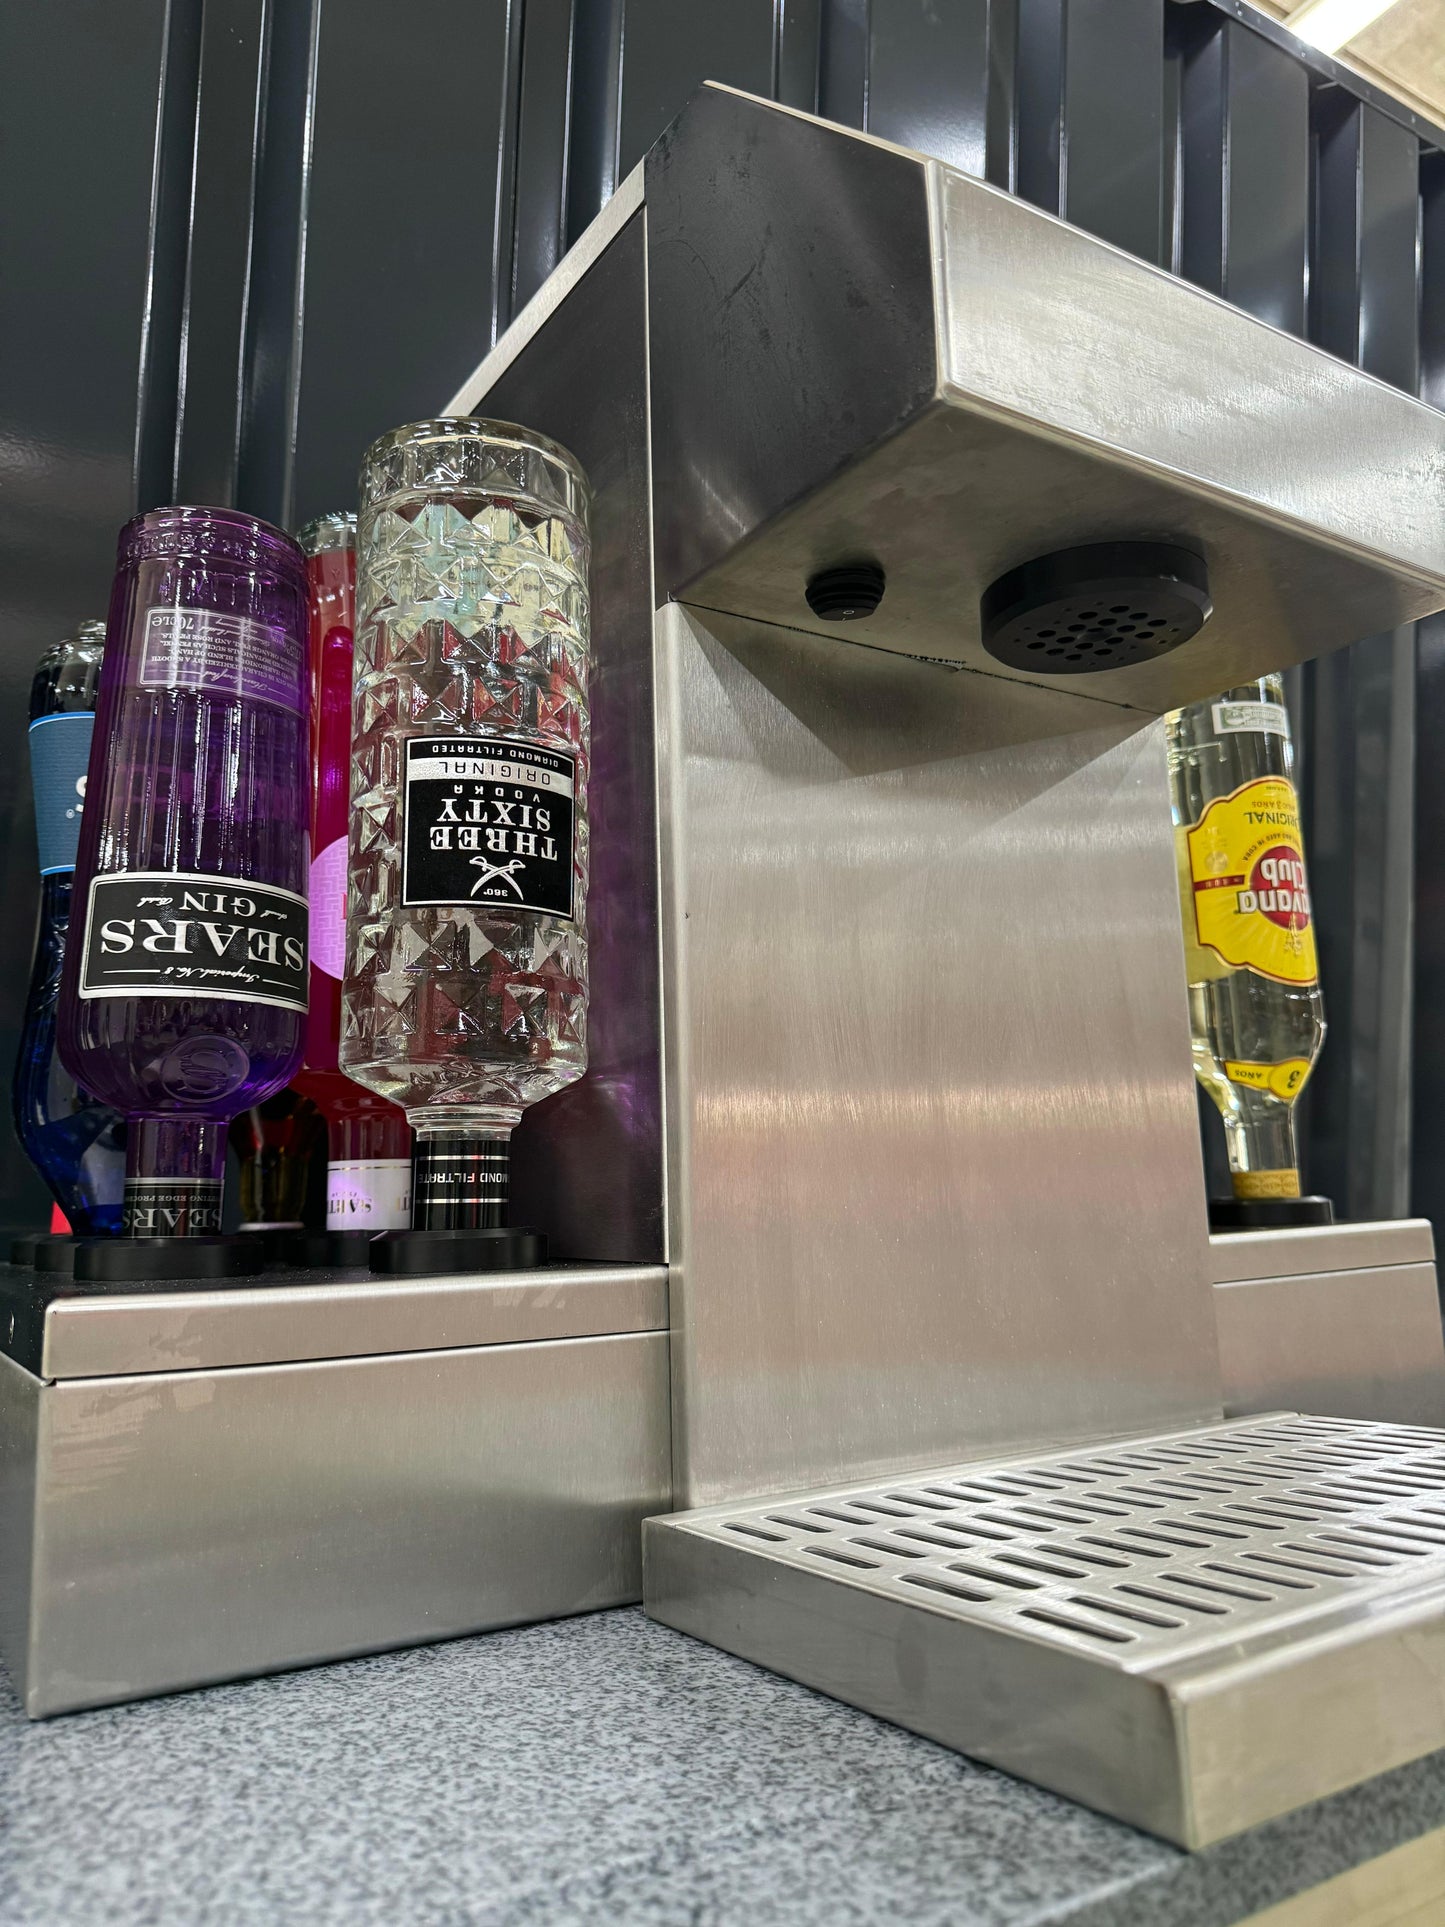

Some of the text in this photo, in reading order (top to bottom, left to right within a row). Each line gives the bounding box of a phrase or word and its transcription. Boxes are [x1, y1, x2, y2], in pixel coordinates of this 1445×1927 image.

[161, 632, 191, 640] PEALS.
[192, 634, 213, 643] ROSE
[215, 637, 231, 645] AND
[207, 651, 233, 661] BLEND
[431, 745, 558, 768] DIAMOND FILTRATED
[438, 761, 551, 786] ORIGINAL
[453, 784, 541, 803] VODKA
[436, 798, 551, 832] SIXTY
[429, 826, 558, 861] THREE
[1260, 857, 1305, 890] Club
[178, 891, 256, 917] GIN
[100, 918, 304, 972] SEARS
[164, 966, 174, 974] 8
[200, 965, 260, 983] Imperial
[1234, 1070, 1300, 1089] 3 AÑOS
